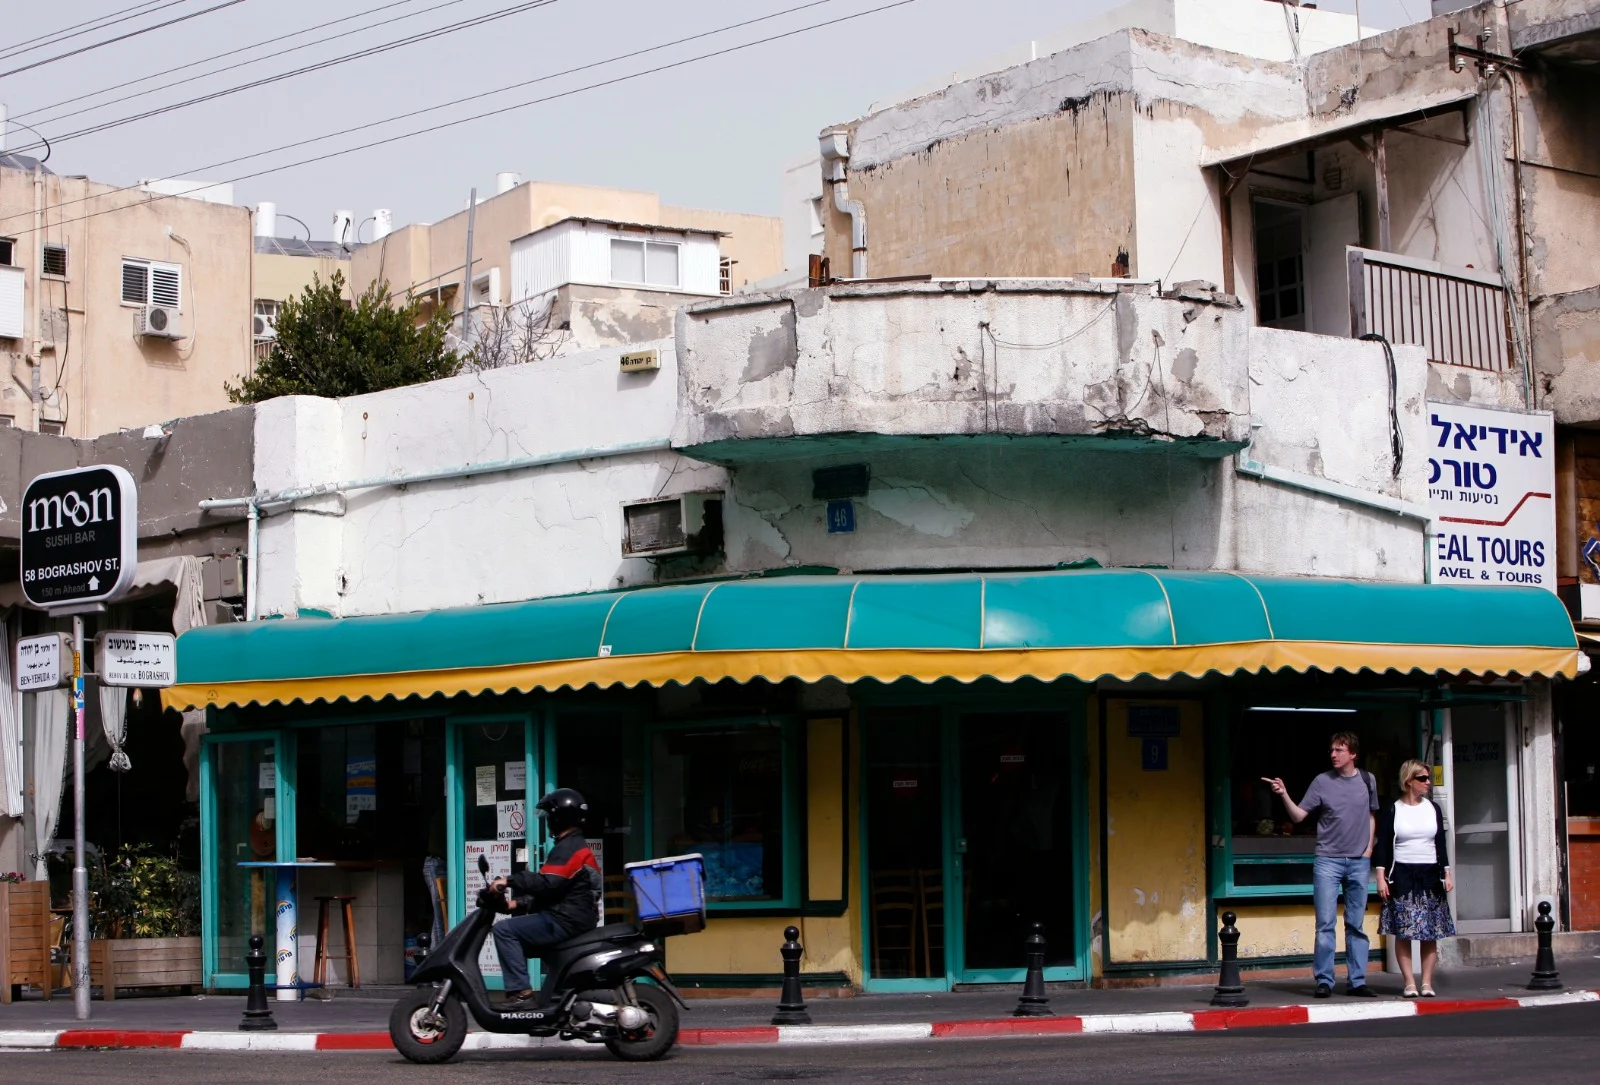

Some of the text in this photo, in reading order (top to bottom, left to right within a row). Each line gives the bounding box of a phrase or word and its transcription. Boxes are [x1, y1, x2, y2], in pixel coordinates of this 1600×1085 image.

[620, 356, 630, 366] 46
[1431, 414, 1542, 458] אידיאל
[1460, 491, 1498, 504] נסיעות
[28, 487, 114, 532] moon
[834, 508, 847, 527] 46
[46, 530, 96, 548] SUSHI BAR
[1477, 536, 1544, 568] TOURS
[25, 558, 120, 582] 58 BOGRASHOV ST.
[1480, 570, 1490, 580] &
[1497, 571, 1542, 584] TOURS
[63, 583, 86, 594] Ahead
[108, 638, 136, 650] בוגרשוב
[20, 672, 50, 686] BEN-YEHUDA
[138, 670, 170, 680] BOGRASHOV
[466, 846, 484, 854] Menu
[490, 844, 509, 854] מחירון
